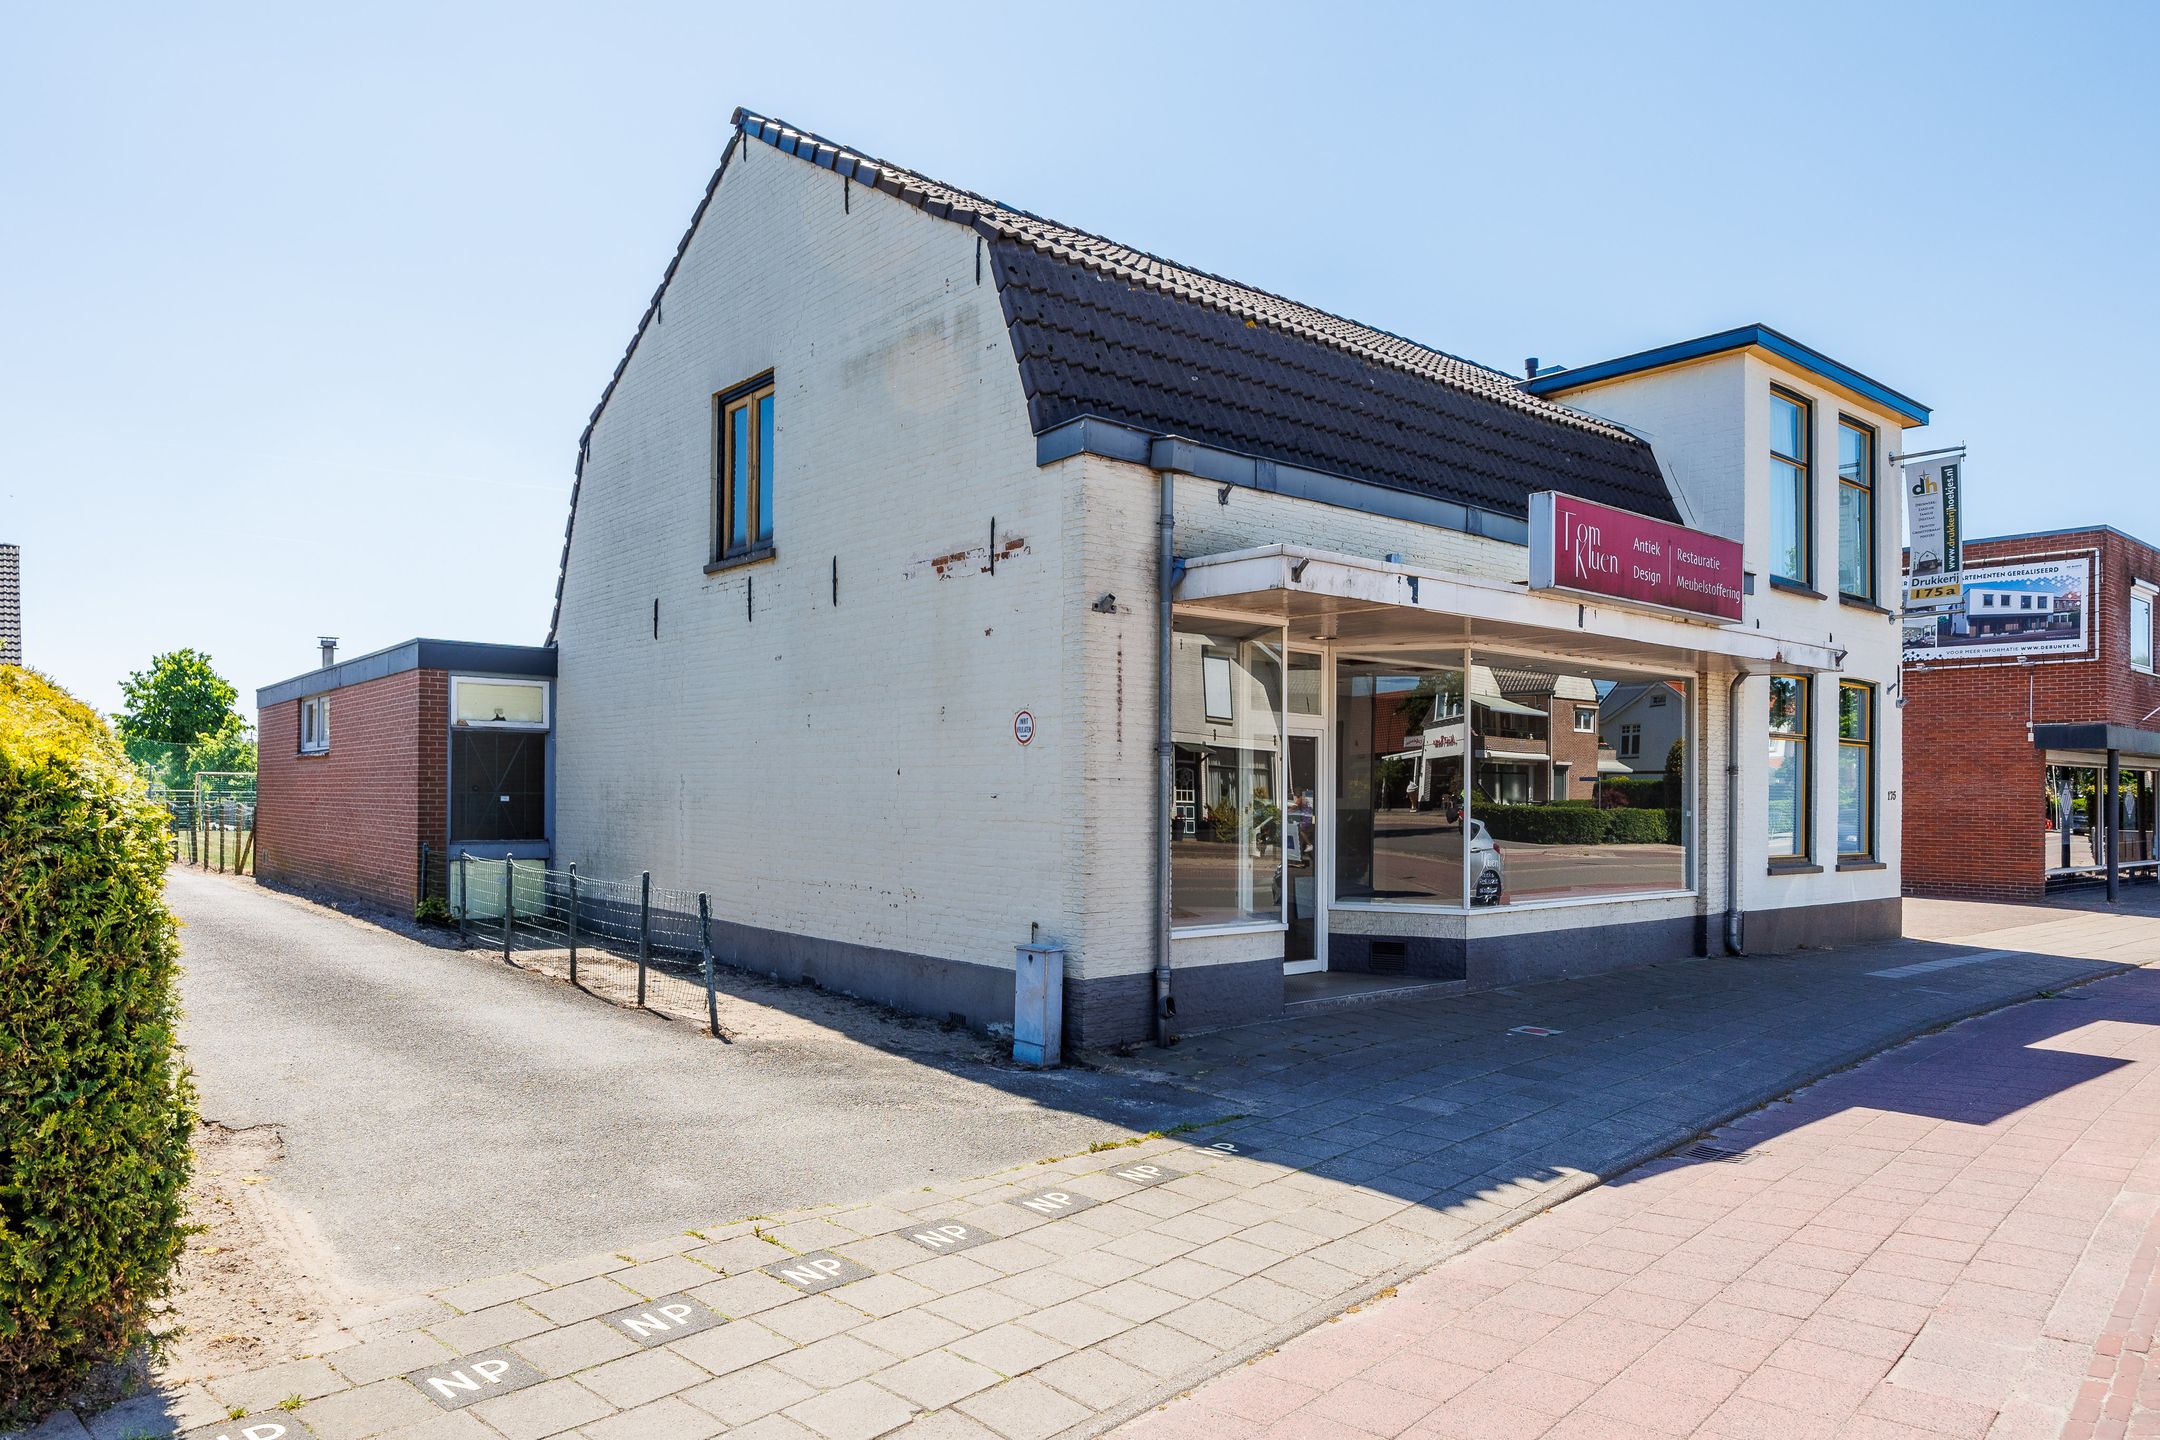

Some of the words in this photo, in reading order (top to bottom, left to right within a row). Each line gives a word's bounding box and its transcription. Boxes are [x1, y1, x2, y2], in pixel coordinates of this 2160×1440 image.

[1944, 467, 1957, 571] www.drukkerijhoekjes.nl
[1556, 509, 1601, 552] Tom
[1633, 537, 1661, 556] Antiek
[1575, 538, 1619, 579] Kluen
[1677, 547, 1720, 570] Restauratie
[1633, 565, 1661, 587] Design
[1911, 573, 1960, 587] Drukkerij
[1962, 571, 2006, 580] RTEMENTEN
[2007, 566, 2059, 577] GEREALISEERD
[1676, 575, 1741, 603] Meubelstoffering
[1915, 587, 1957, 599] 175a
[2020, 643, 2081, 651] WWW.DEBUNTE.NL
[1196, 1142, 1239, 1158] NP
[1116, 1165, 1162, 1182] NP
[1023, 1193, 1073, 1212] NP
[913, 1224, 968, 1247] NP
[781, 1259, 841, 1286] NP
[621, 1304, 692, 1337] NP
[427, 1359, 510, 1398] NP
[216, 1423, 287, 1440] P
